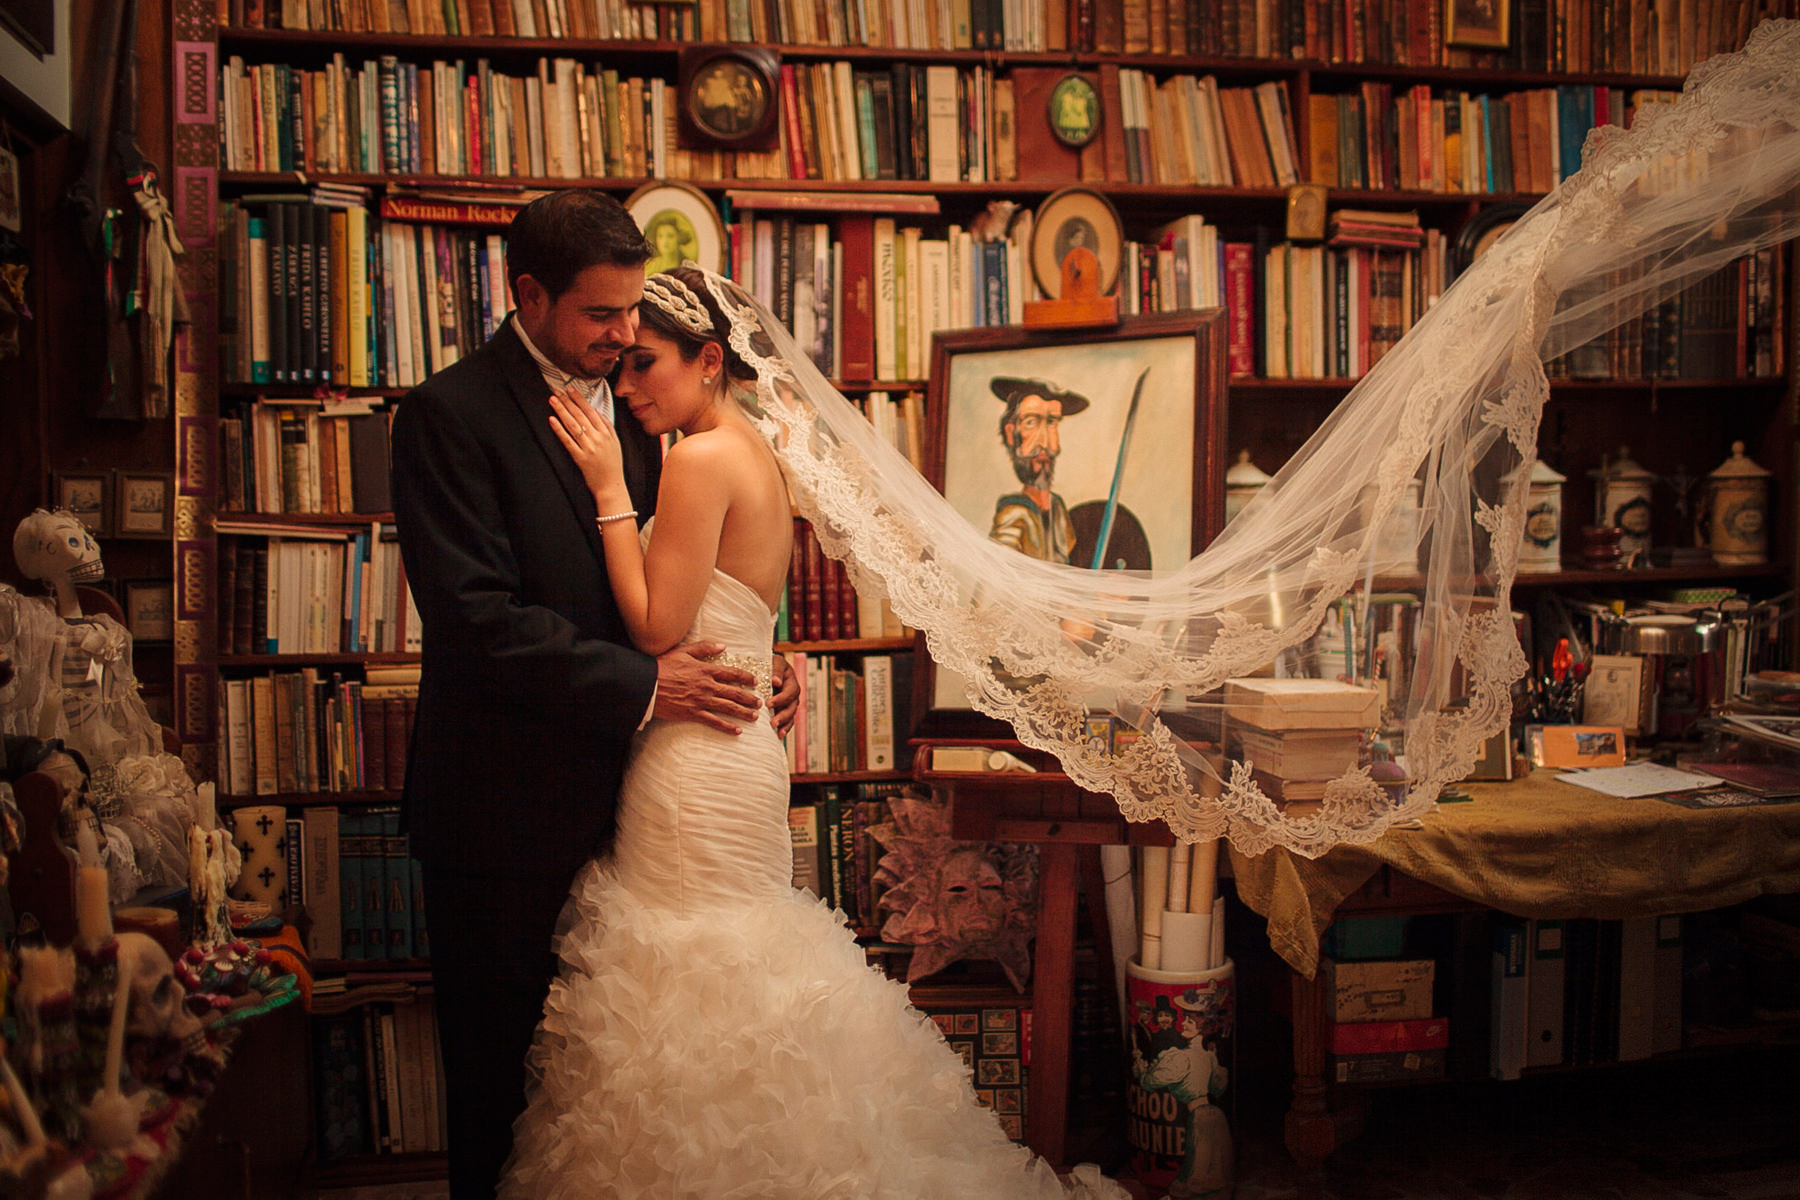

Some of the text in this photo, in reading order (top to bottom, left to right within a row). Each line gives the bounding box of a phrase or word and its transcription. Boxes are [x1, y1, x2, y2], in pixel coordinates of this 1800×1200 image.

[386, 199, 458, 221] Norman
[301, 243, 312, 330] FRIDA KAHLO
[319, 245, 329, 353] ALBERTO GIRONELLA
[351, 249, 362, 332] FRIDA KAHLO
[870, 667, 881, 734] Collectibles
[877, 665, 888, 714] Antiques
[840, 808, 855, 862] NERON
